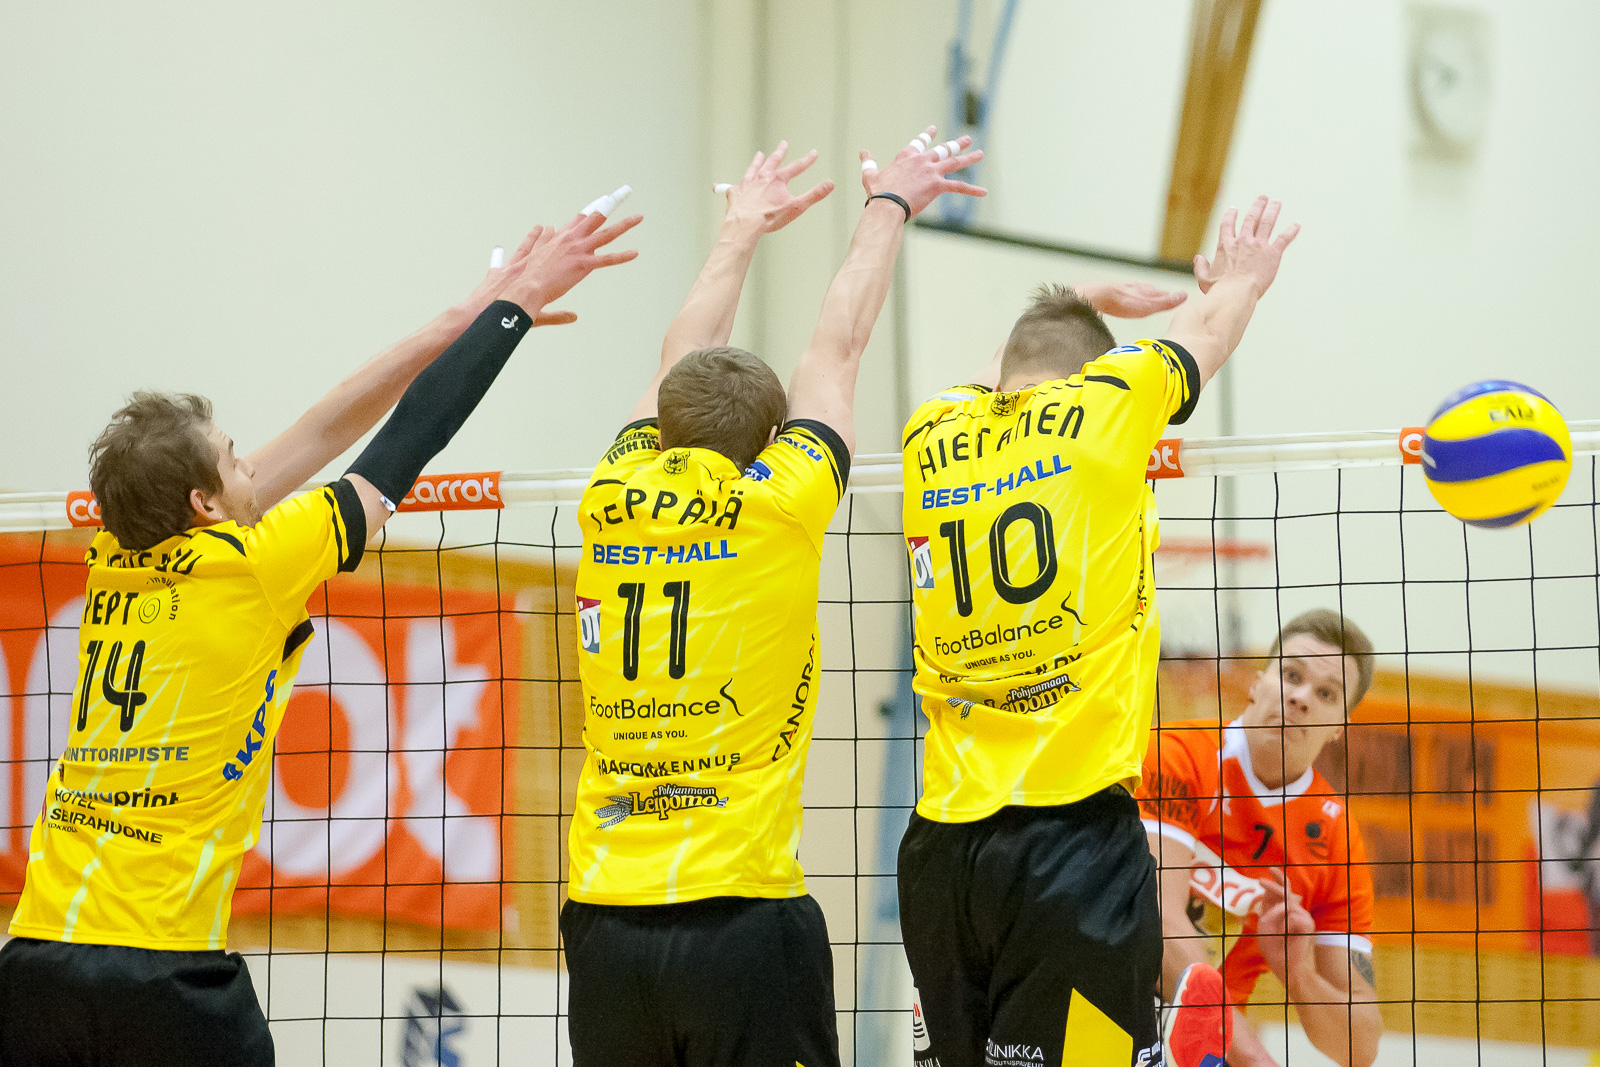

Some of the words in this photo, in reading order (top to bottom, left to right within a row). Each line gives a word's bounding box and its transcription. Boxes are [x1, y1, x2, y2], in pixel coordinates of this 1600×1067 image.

[922, 455, 1071, 510] BEST-HALL
[593, 539, 738, 565] BEST-HALL
[939, 501, 1058, 617] 10
[617, 580, 691, 681] 11
[934, 614, 1063, 656] FootBalance
[964, 656, 999, 670] UNIQUE
[999, 654, 1011, 663] AS
[77, 640, 148, 732] 14
[1009, 673, 1070, 701] Pohjanmaan
[590, 696, 721, 720] FootBalance
[613, 730, 648, 740] UNIQUE
[650, 730, 663, 739] AS
[55, 789, 97, 811] HOTEL
[628, 789, 719, 821] Leipomo
[656, 783, 716, 797] Pohjanmaan
[50, 808, 164, 844] SEIRAHUONE
[1252, 823, 1275, 861] 7
